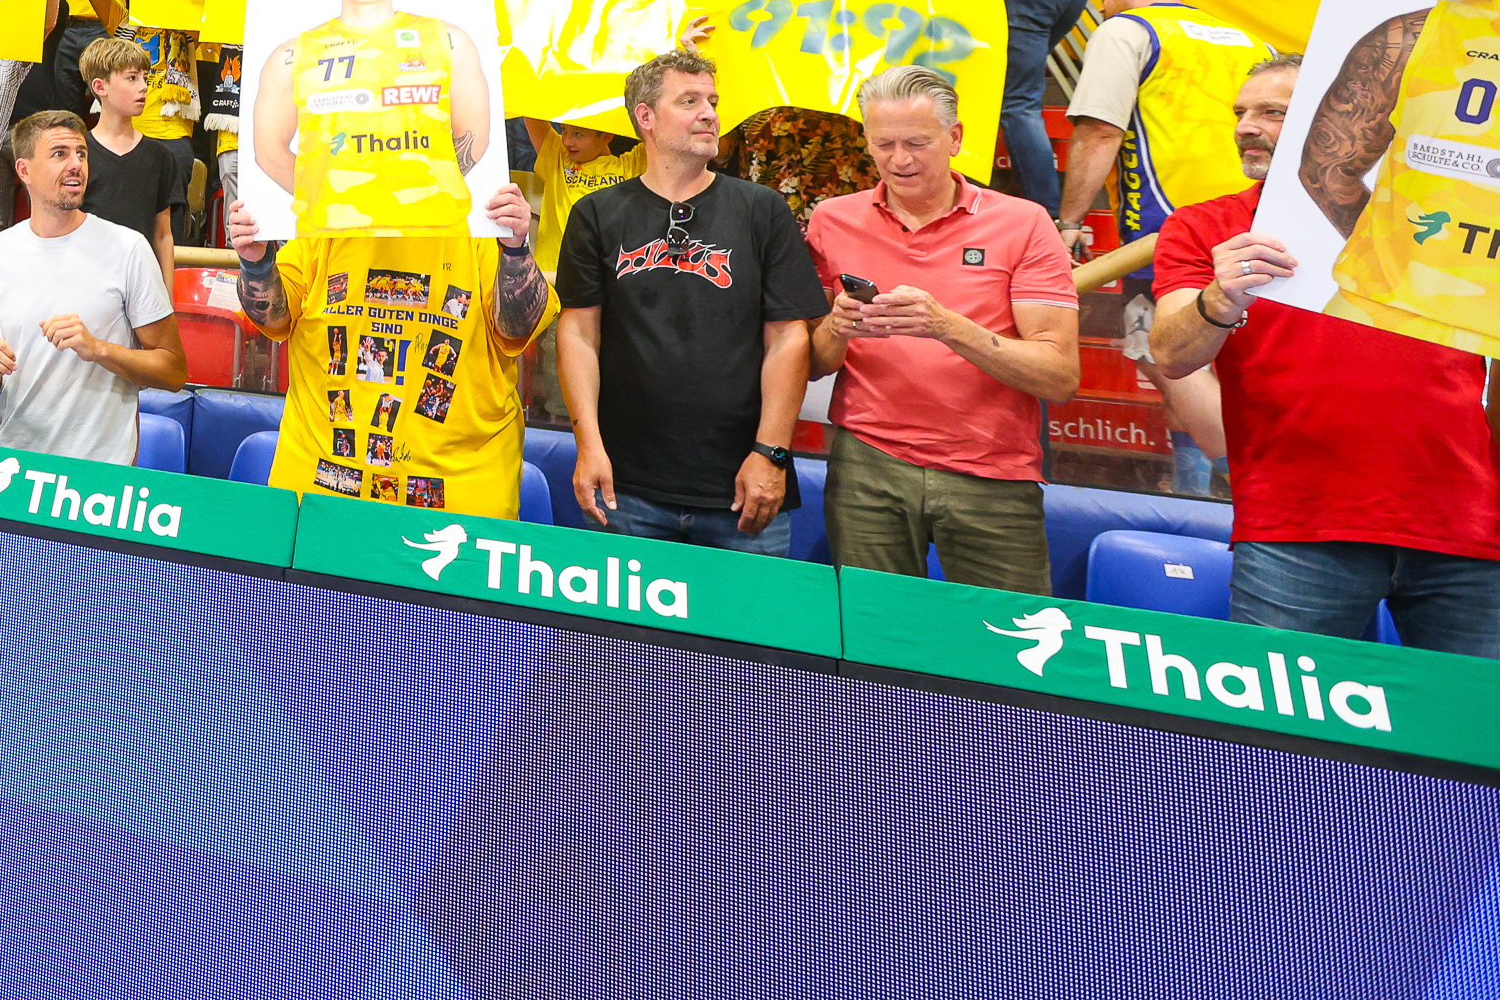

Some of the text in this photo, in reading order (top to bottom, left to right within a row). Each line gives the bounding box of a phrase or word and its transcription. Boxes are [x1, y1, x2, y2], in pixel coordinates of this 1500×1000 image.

[318, 55, 355, 82] 77
[384, 87, 439, 105] REWE
[351, 130, 430, 153] Thalia
[368, 307, 414, 322] GUTEN
[419, 312, 458, 330] DINGE
[371, 322, 403, 335] SIND
[22, 470, 182, 541] Thalia
[477, 539, 690, 620] Thalia
[1081, 626, 1394, 733] Thalia
